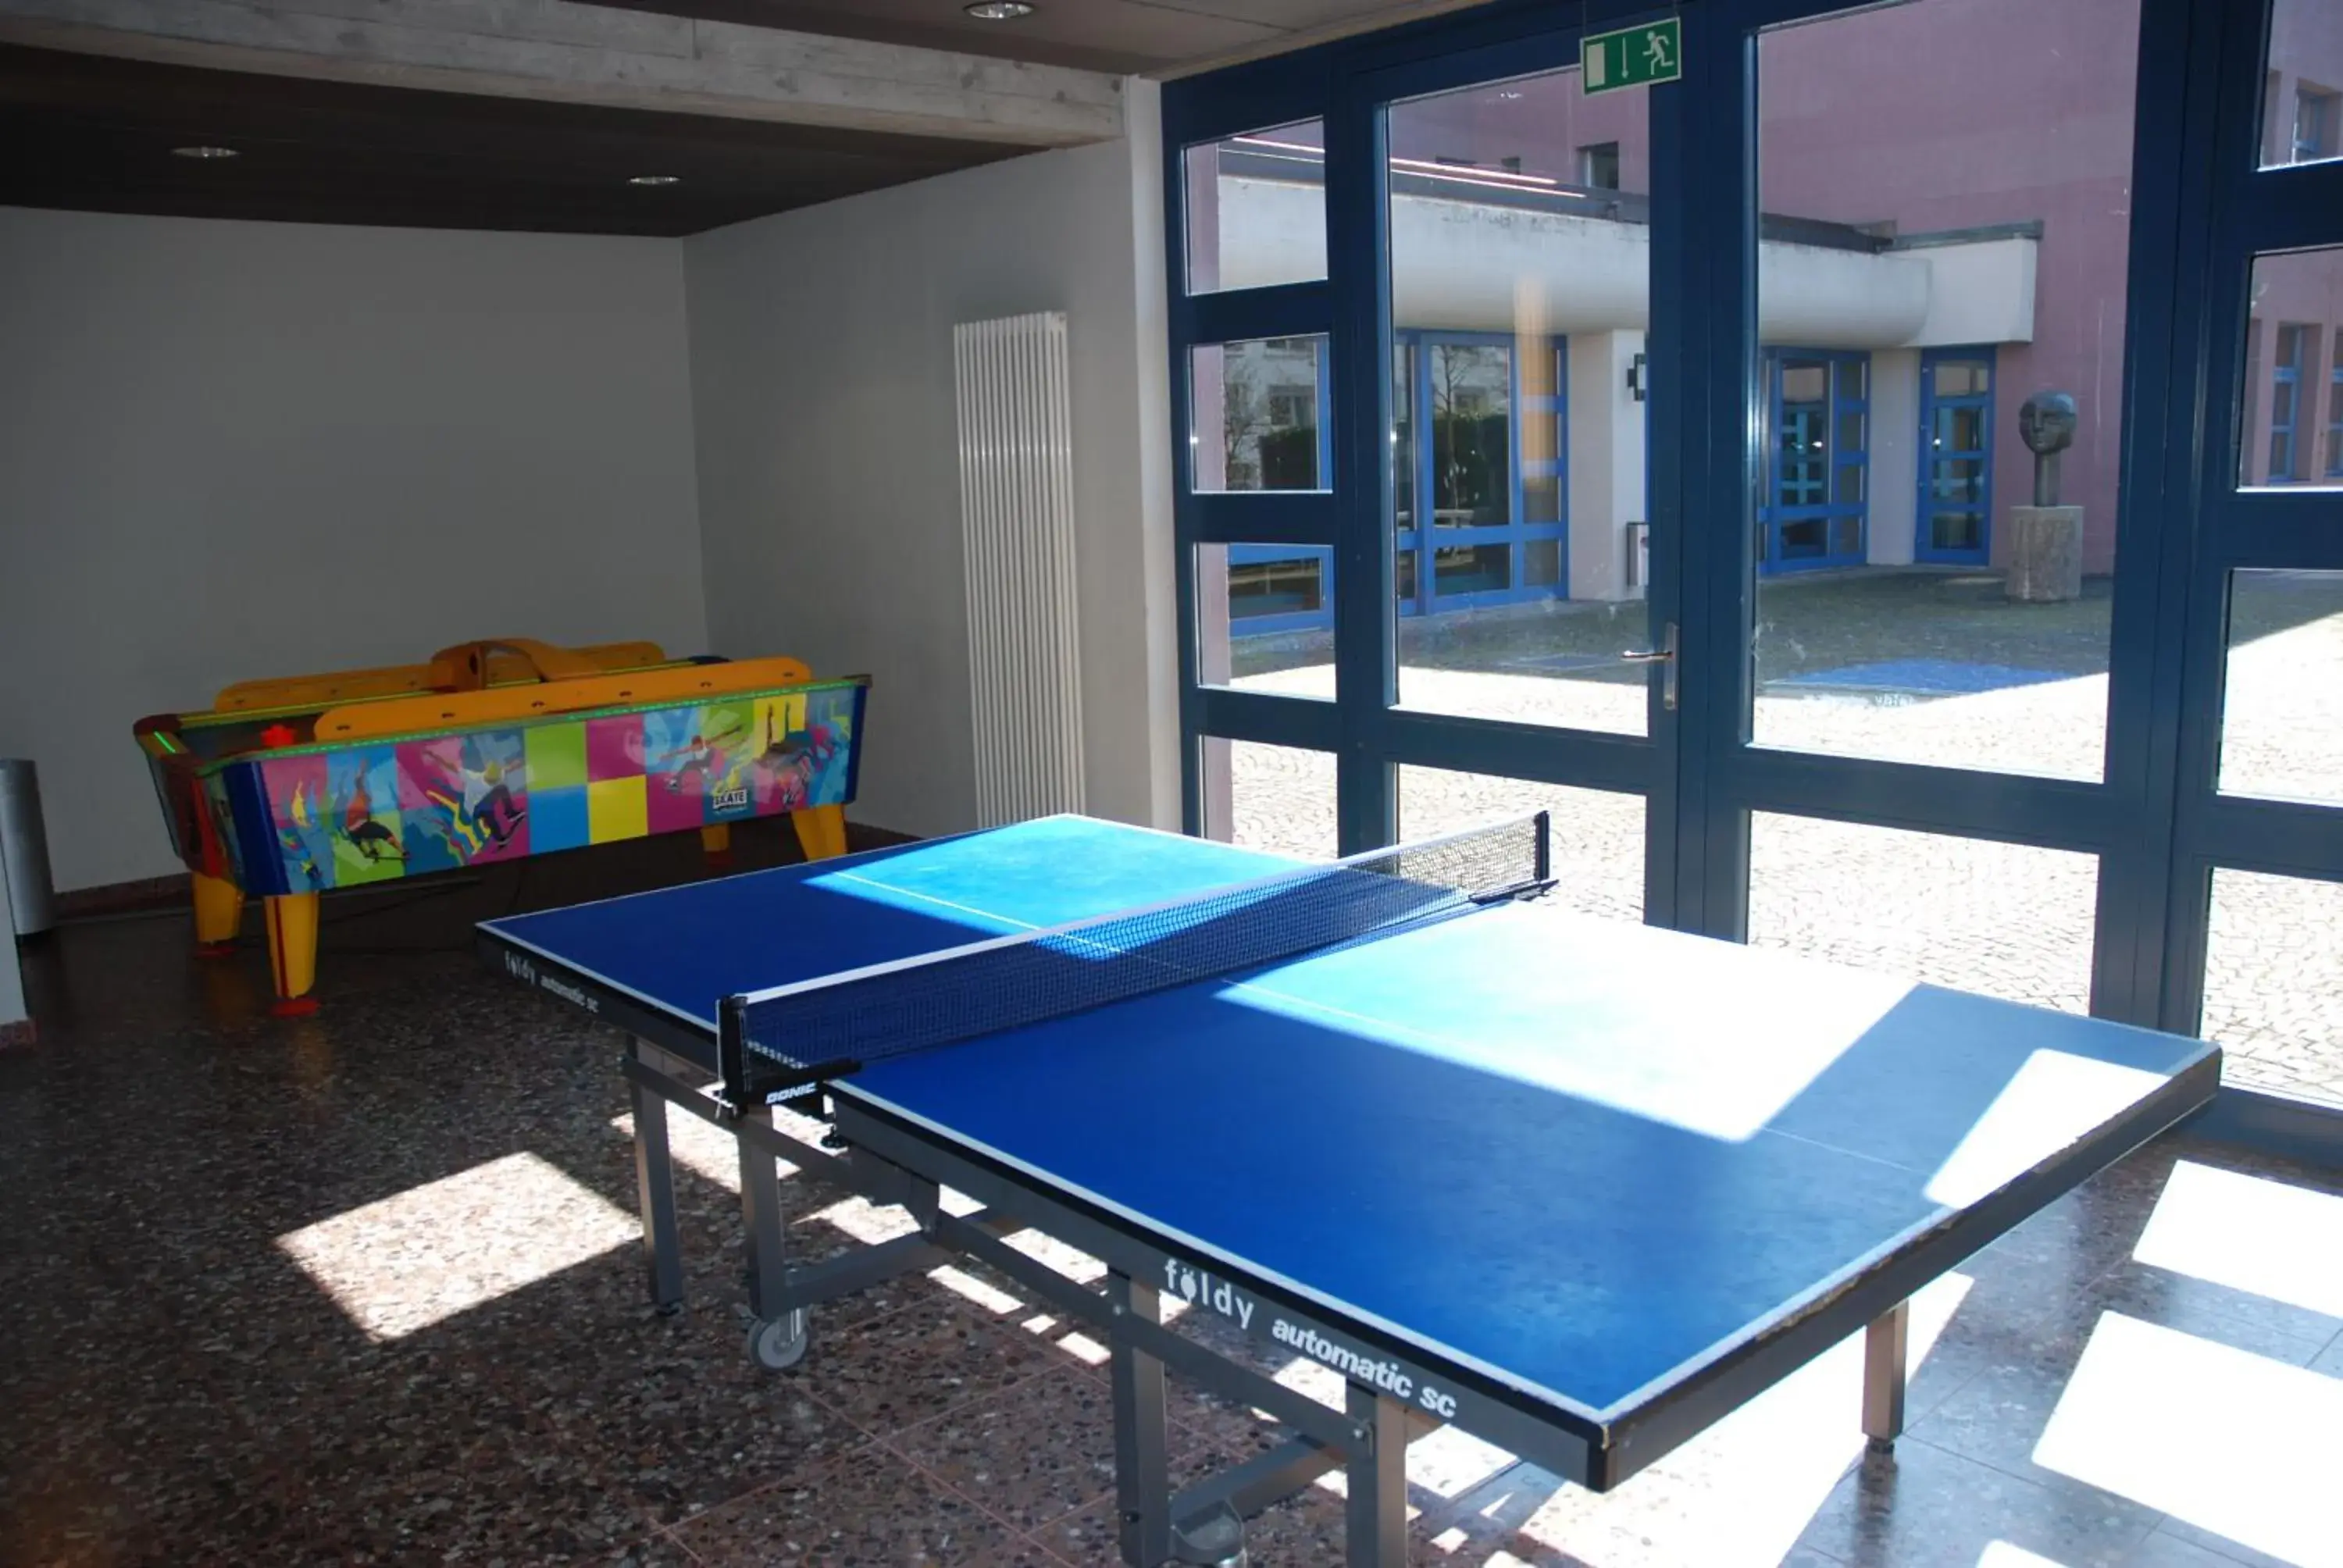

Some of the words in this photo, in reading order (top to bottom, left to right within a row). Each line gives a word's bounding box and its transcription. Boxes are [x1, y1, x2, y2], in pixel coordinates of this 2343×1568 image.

[765, 1082, 817, 1104] DONIC
[1271, 1318, 1413, 1399] automatic
[1419, 1385, 1456, 1417] sc
